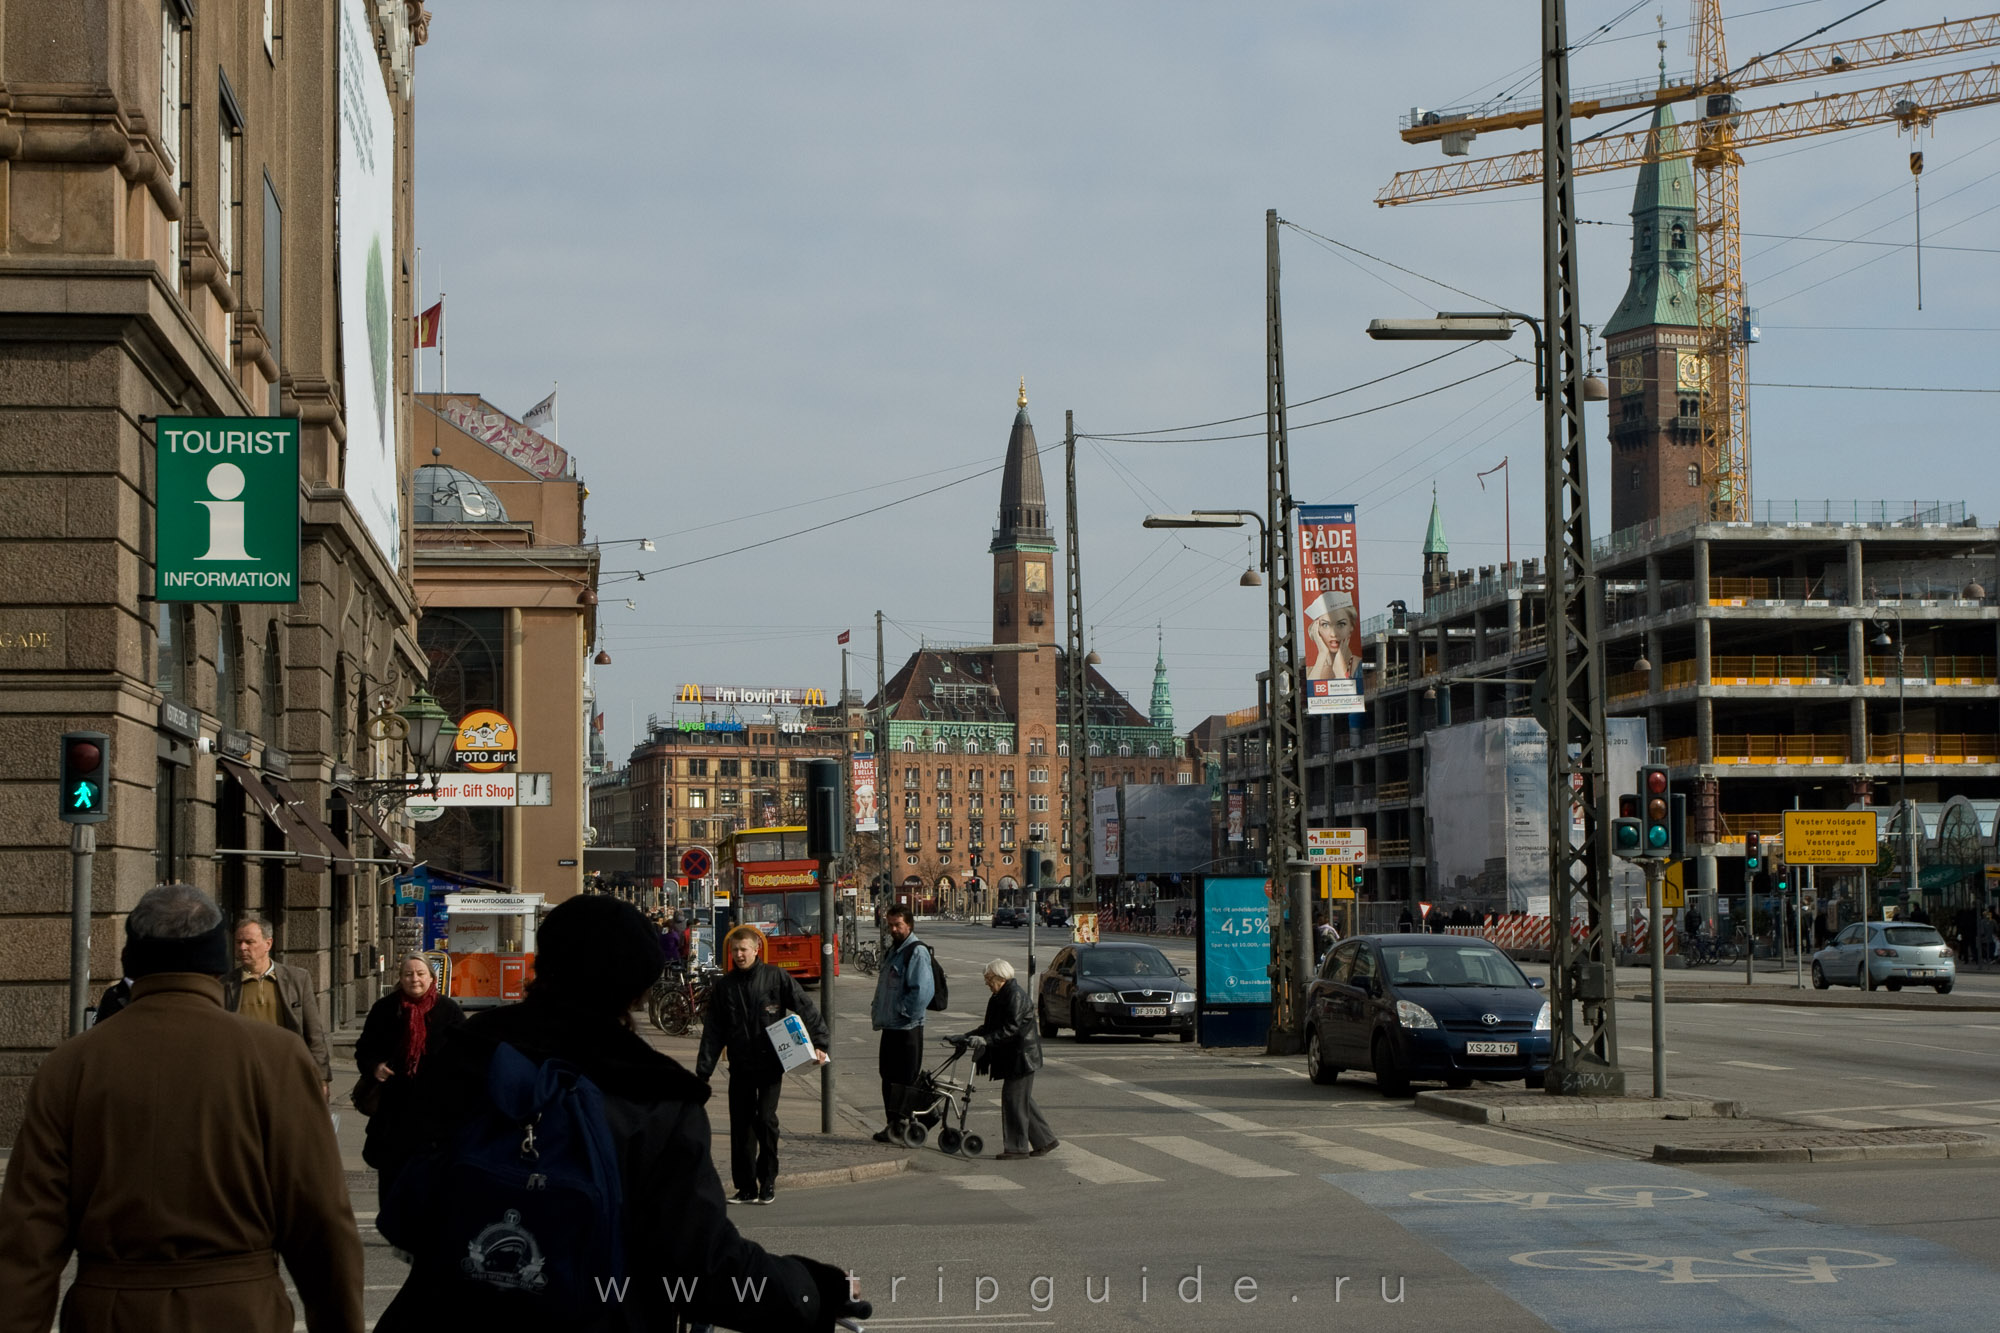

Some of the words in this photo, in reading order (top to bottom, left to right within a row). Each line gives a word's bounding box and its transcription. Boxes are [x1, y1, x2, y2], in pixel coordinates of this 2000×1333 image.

[164, 430, 291, 454] TOURIST
[1302, 525, 1353, 550] BÅDE
[1303, 551, 1308, 565] I
[1312, 550, 1354, 565] BELLA
[164, 571, 291, 587] INFORMATION
[1305, 574, 1355, 592] marts
[715, 687, 736, 702] i'm
[740, 688, 778, 704] lovin'
[781, 689, 791, 704] it
[678, 719, 743, 733] Lycamobile
[781, 723, 808, 734] CITY
[941, 726, 996, 740] PALACE
[1088, 728, 1127, 741] OTEL
[455, 751, 489, 763] FOTO
[492, 751, 517, 763] dirk
[854, 760, 874, 770] BÅDE
[463, 784, 483, 798] Gift
[486, 784, 515, 800] Shop
[1795, 818, 1824, 826] Vester
[1826, 818, 1867, 827] Voldgade
[1807, 839, 1856, 848] Vestergade
[460, 897, 525, 905] WWW.HOTDOGDELI.DK
[1221, 917, 1271, 937] 4,5%
[777, 1042, 791, 1053] 42x
[1469, 1044, 1482, 1053] XS
[1484, 1044, 1496, 1053] 22
[1499, 1044, 1516, 1053] 167
